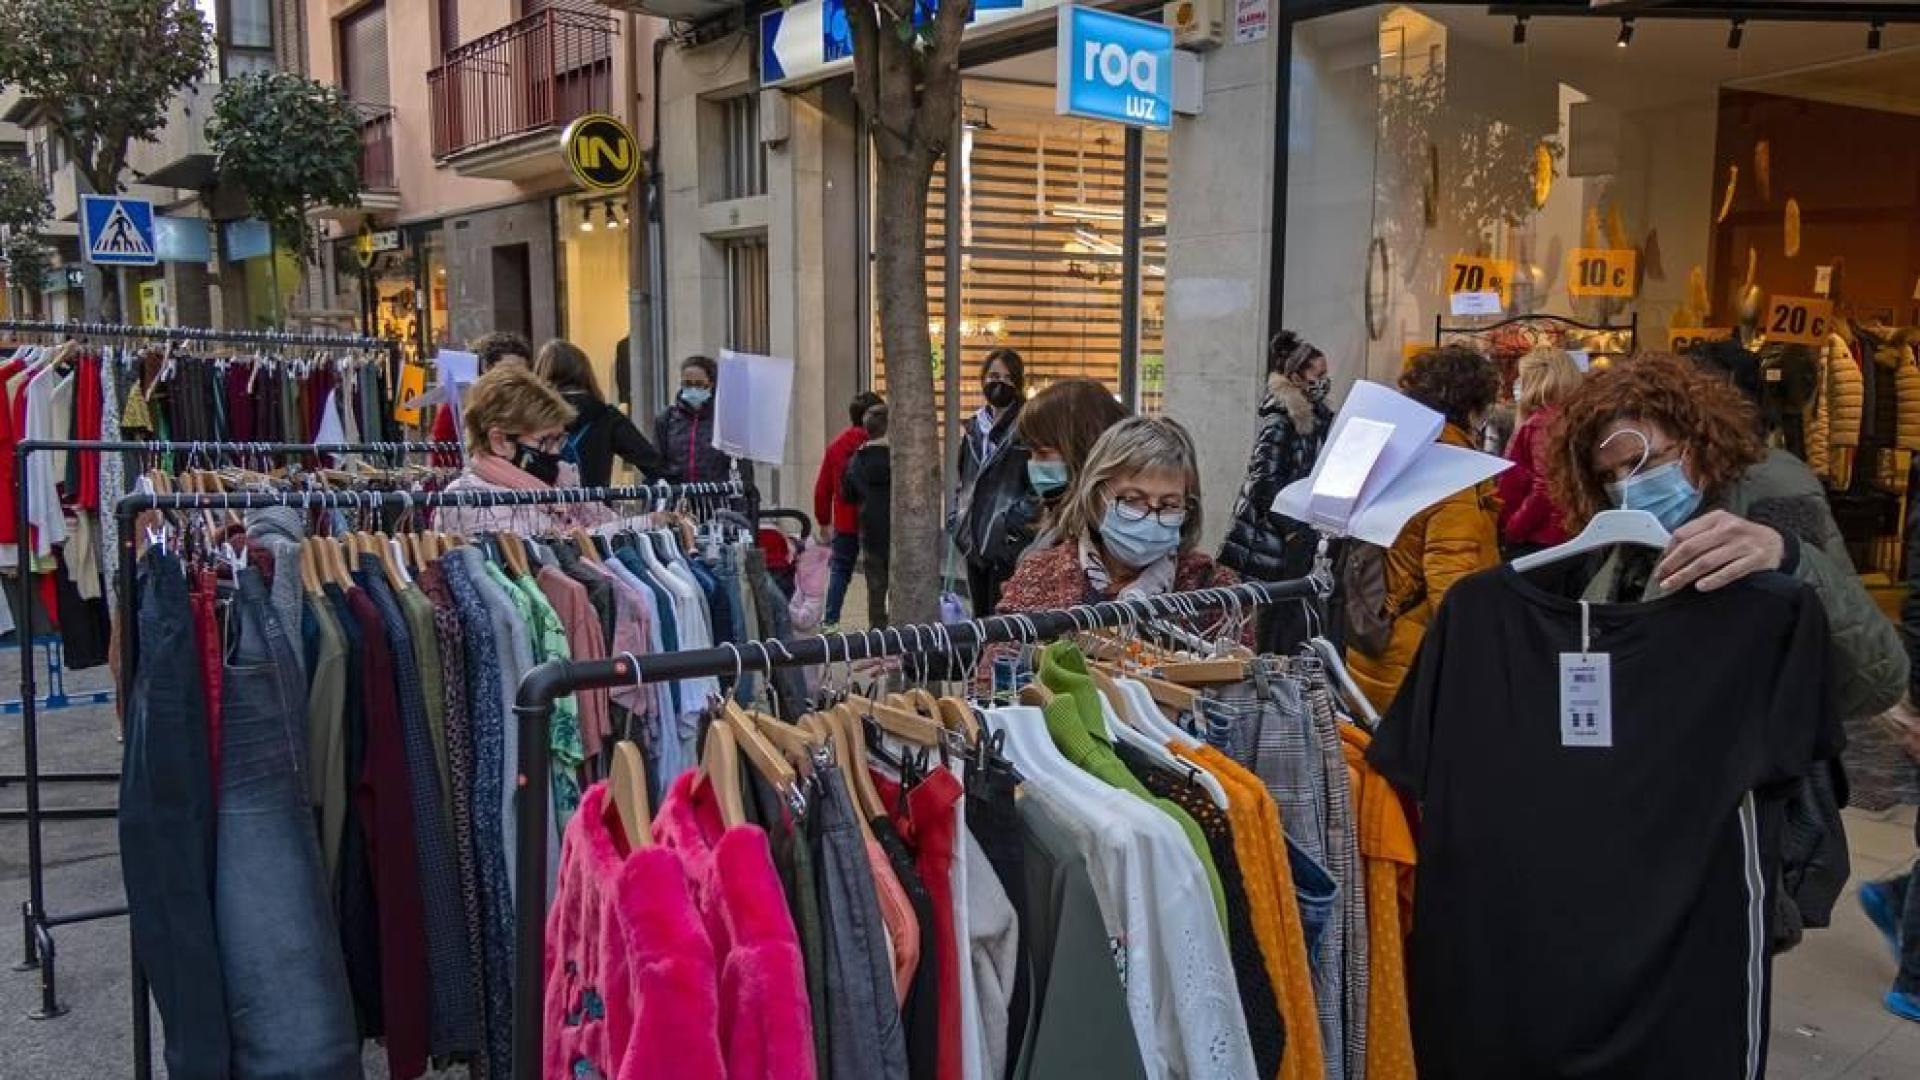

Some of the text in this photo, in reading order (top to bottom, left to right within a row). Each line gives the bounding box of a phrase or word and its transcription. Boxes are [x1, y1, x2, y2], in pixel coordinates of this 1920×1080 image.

[1085, 41, 1156, 94] roa
[1126, 95, 1155, 120] LUZ
[579, 136, 629, 169] IN
[1454, 263, 1485, 293] 70
[1579, 258, 1607, 288] 10
[1772, 304, 1807, 335] 20
